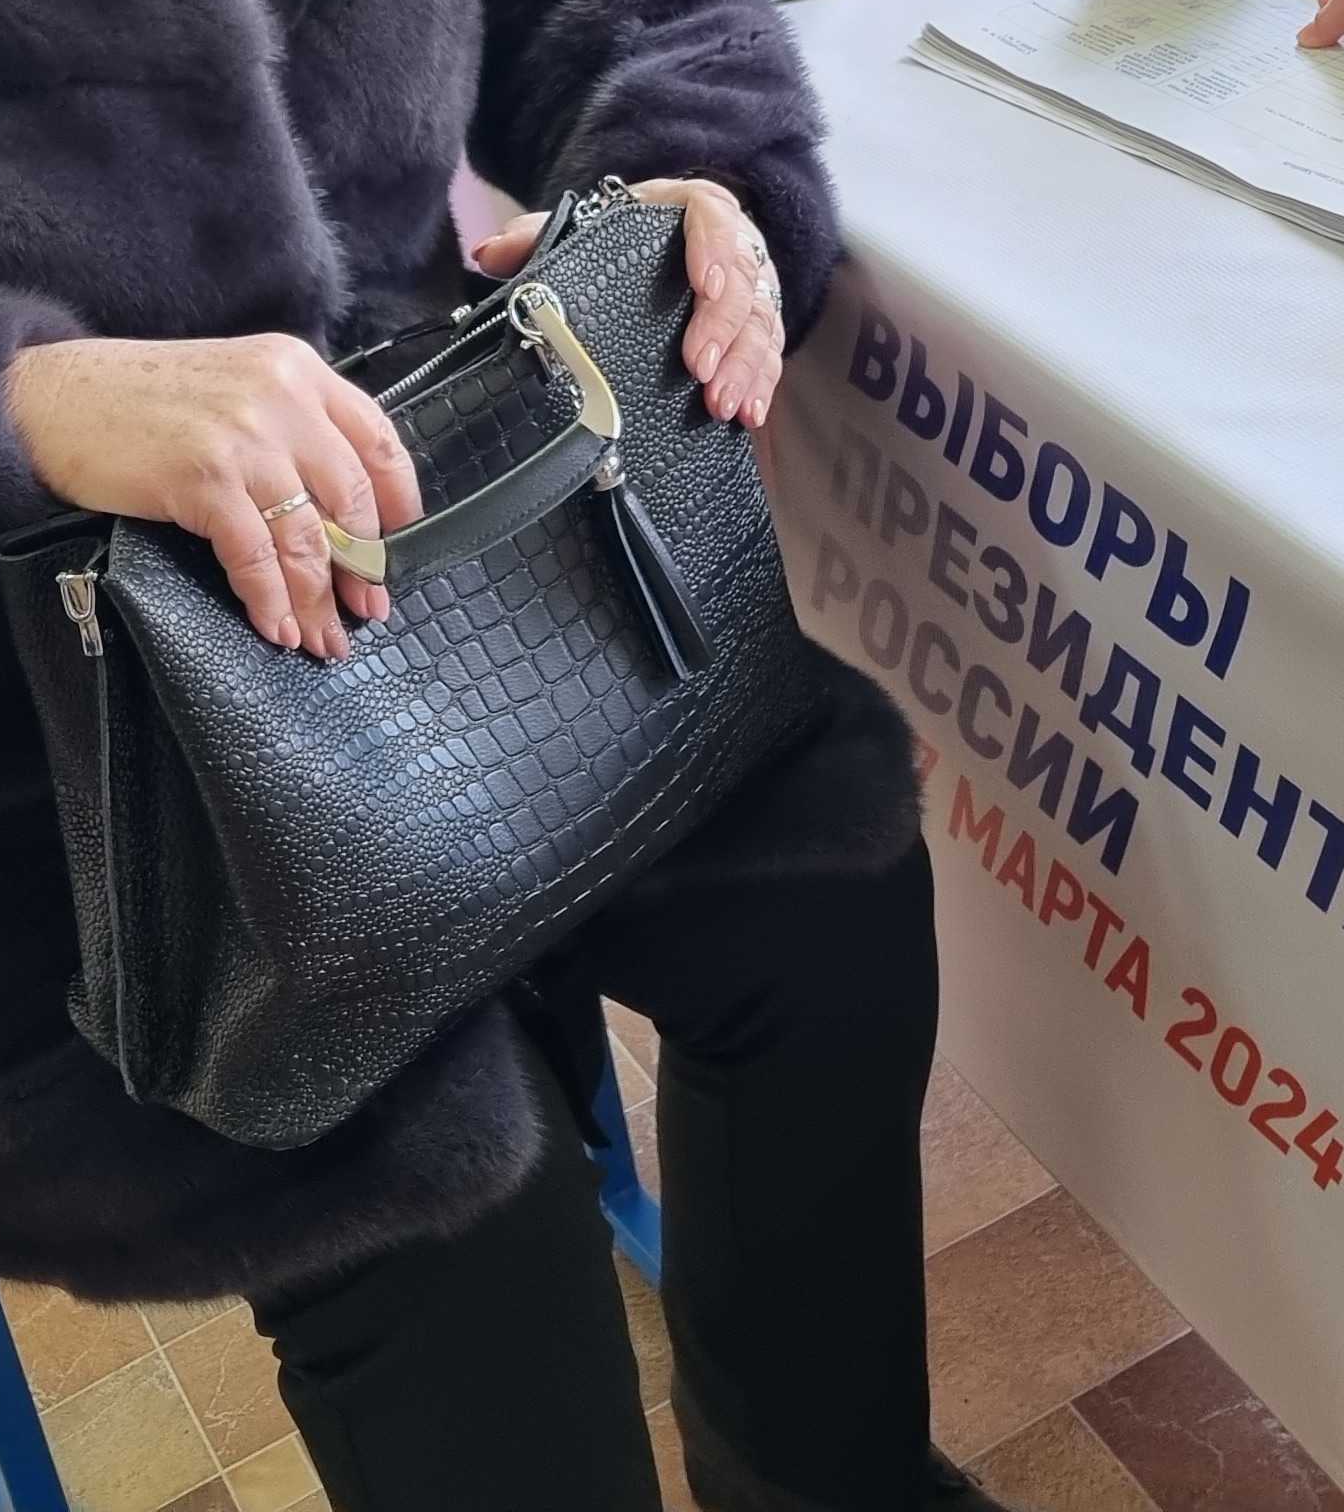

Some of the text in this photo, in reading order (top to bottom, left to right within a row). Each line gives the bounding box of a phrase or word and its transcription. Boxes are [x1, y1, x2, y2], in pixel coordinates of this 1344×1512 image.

[848, 299, 1250, 681] ВЫБОРЫ
[810, 531, 1140, 875] РОССИИ
[947, 775, 1344, 1191] МАРТА 2024
